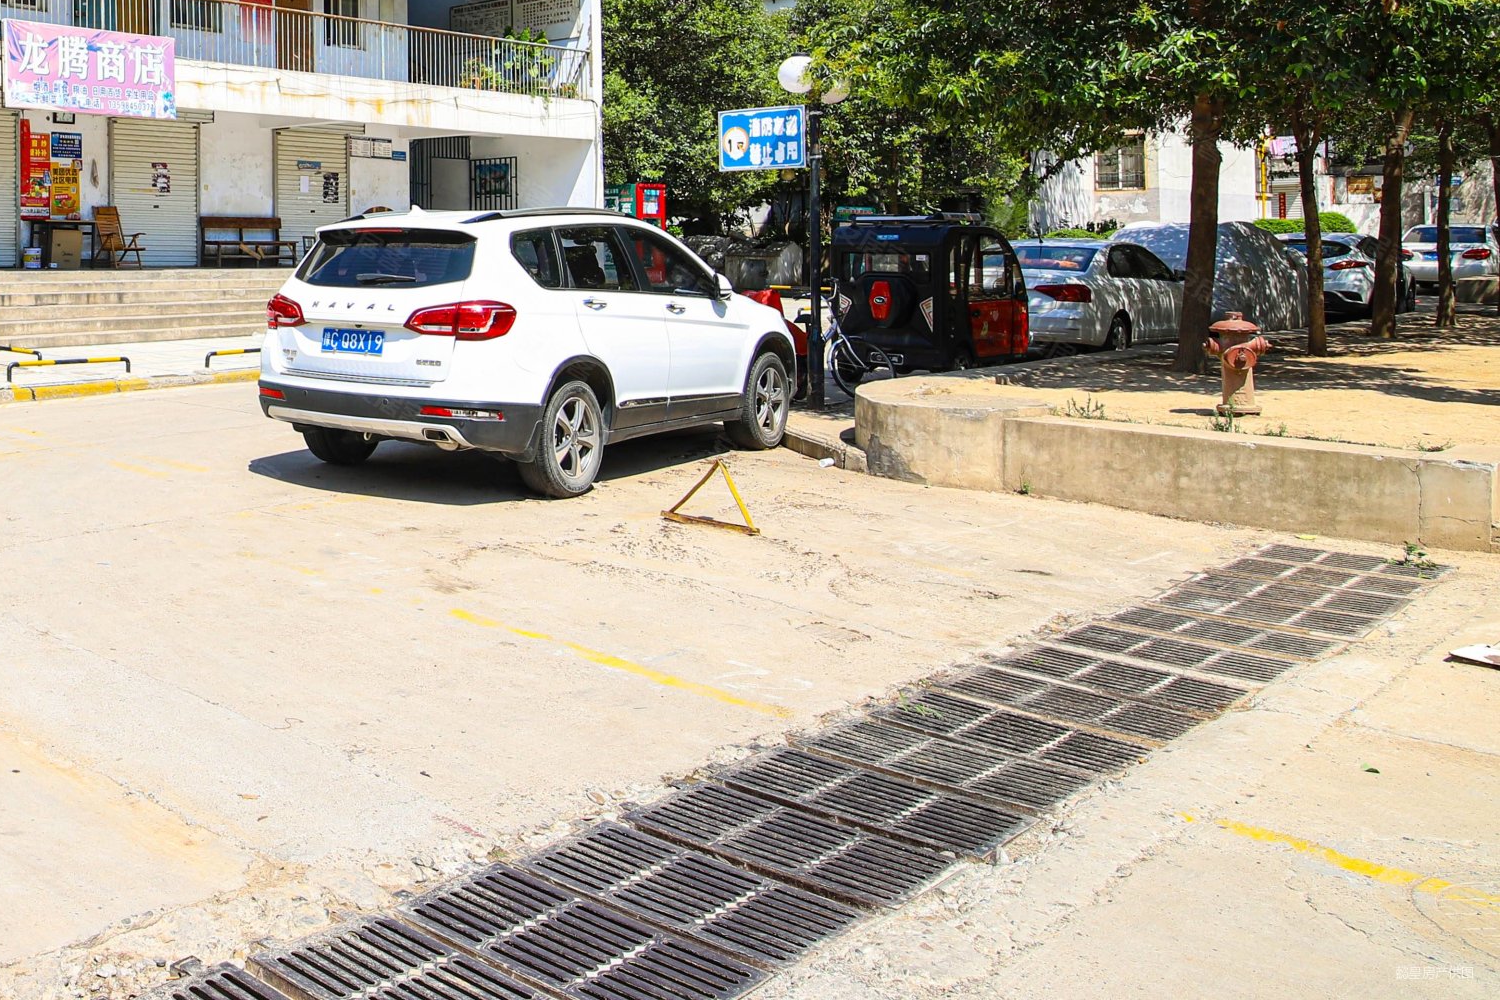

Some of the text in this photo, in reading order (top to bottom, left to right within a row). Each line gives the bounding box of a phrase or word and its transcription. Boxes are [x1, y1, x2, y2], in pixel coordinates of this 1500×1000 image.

[18, 32, 164, 86] 龙腾商店
[33, 81, 155, 101] 烟酒 副食 粮油 日用百货 学生用品
[85, 98, 101, 109] 电话
